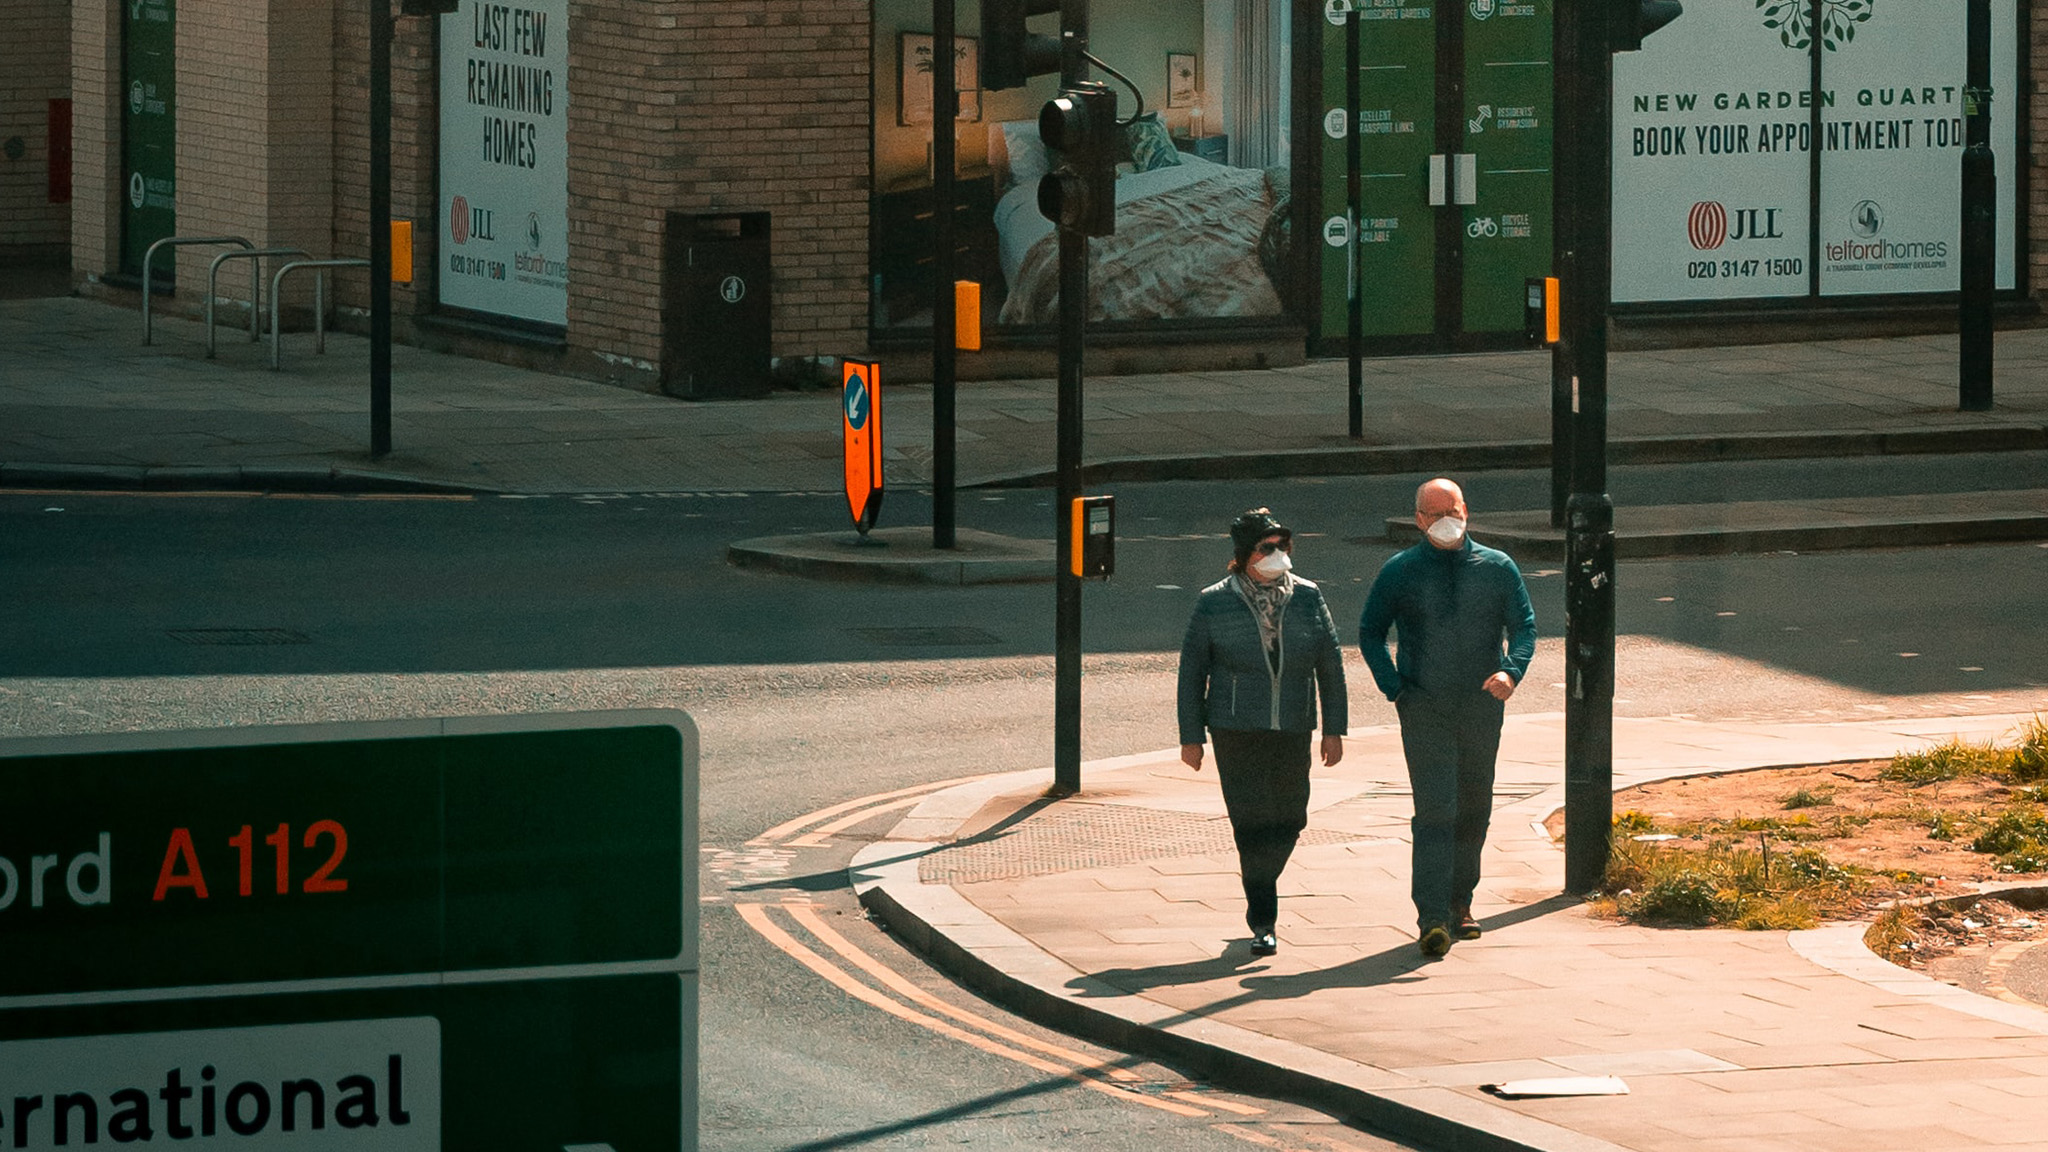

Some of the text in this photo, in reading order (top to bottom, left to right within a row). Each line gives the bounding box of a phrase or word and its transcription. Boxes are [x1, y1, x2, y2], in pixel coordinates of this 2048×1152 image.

[475, 2, 547, 58] LAST FEW
[468, 58, 552, 116] REMAINING
[1633, 94, 1697, 113] NEW
[1714, 90, 1835, 110] GARDEN
[1857, 86, 1993, 106] QUART
[484, 115, 536, 169] HOMES
[1633, 126, 1687, 156] BOOK
[1695, 125, 1749, 155] YOUR
[471, 208, 495, 240] JLL
[1729, 208, 1784, 240] JLL
[451, 254, 465, 274] 020
[467, 257, 485, 277] 3147
[1825, 239, 1948, 262] telfordhomes
[1688, 258, 1803, 279] 020 3147 1500
[0, 1054, 411, 1149] rnational
